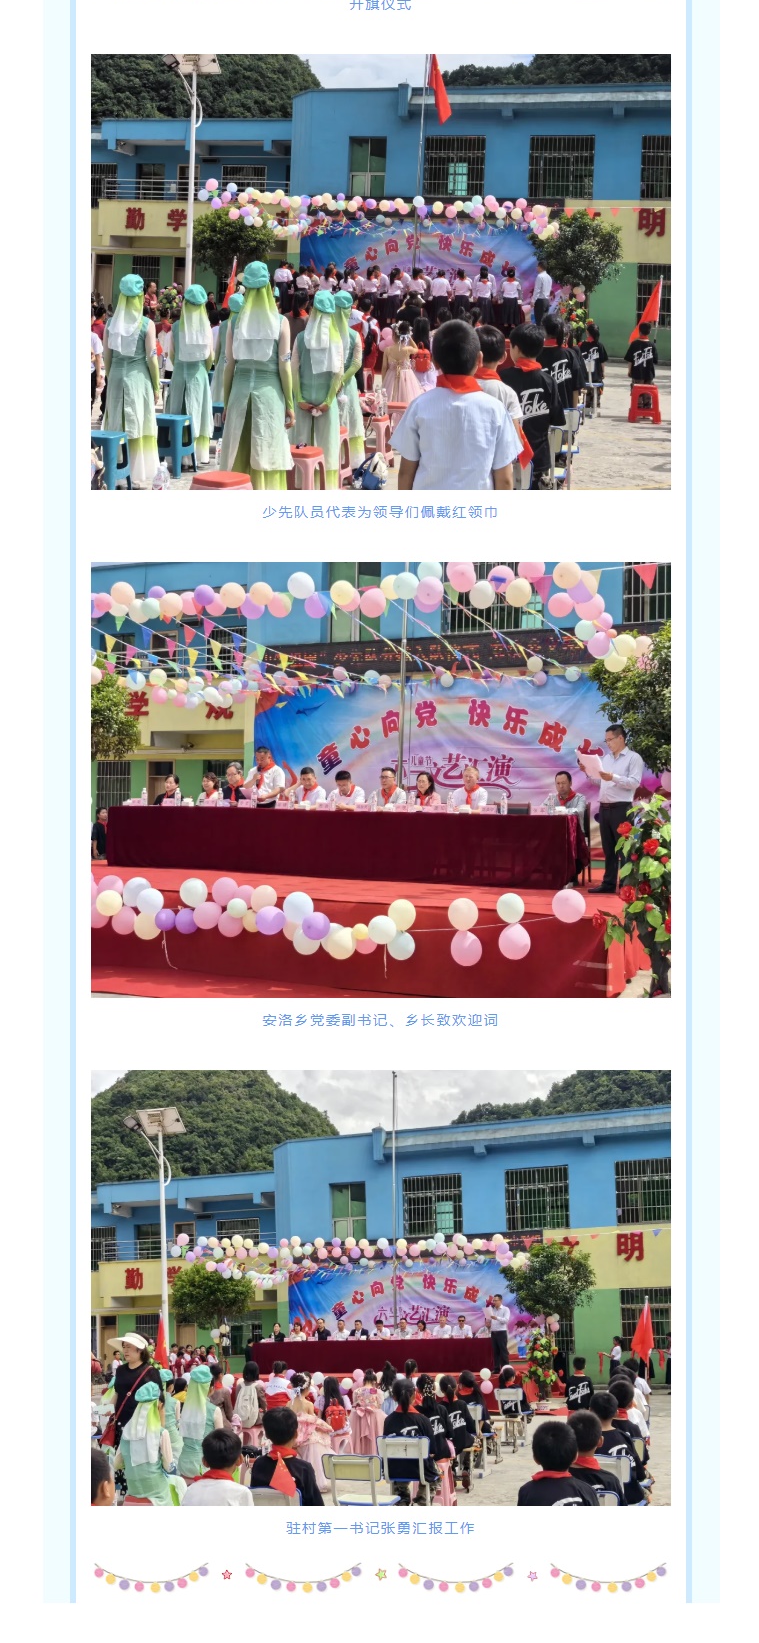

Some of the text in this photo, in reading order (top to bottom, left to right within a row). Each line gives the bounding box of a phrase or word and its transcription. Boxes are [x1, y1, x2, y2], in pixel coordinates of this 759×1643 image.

[262, 505, 498, 519] 少先队员代表为领导们佩戴红领巾
[316, 699, 438, 775] 童心向党
[262, 1013, 499, 1028] 安洛乡党委副书记、乡长致欢迎词
[331, 1274, 405, 1321] 童心向党
[285, 1521, 475, 1535] 驻村第一书记张勇汇报工作
